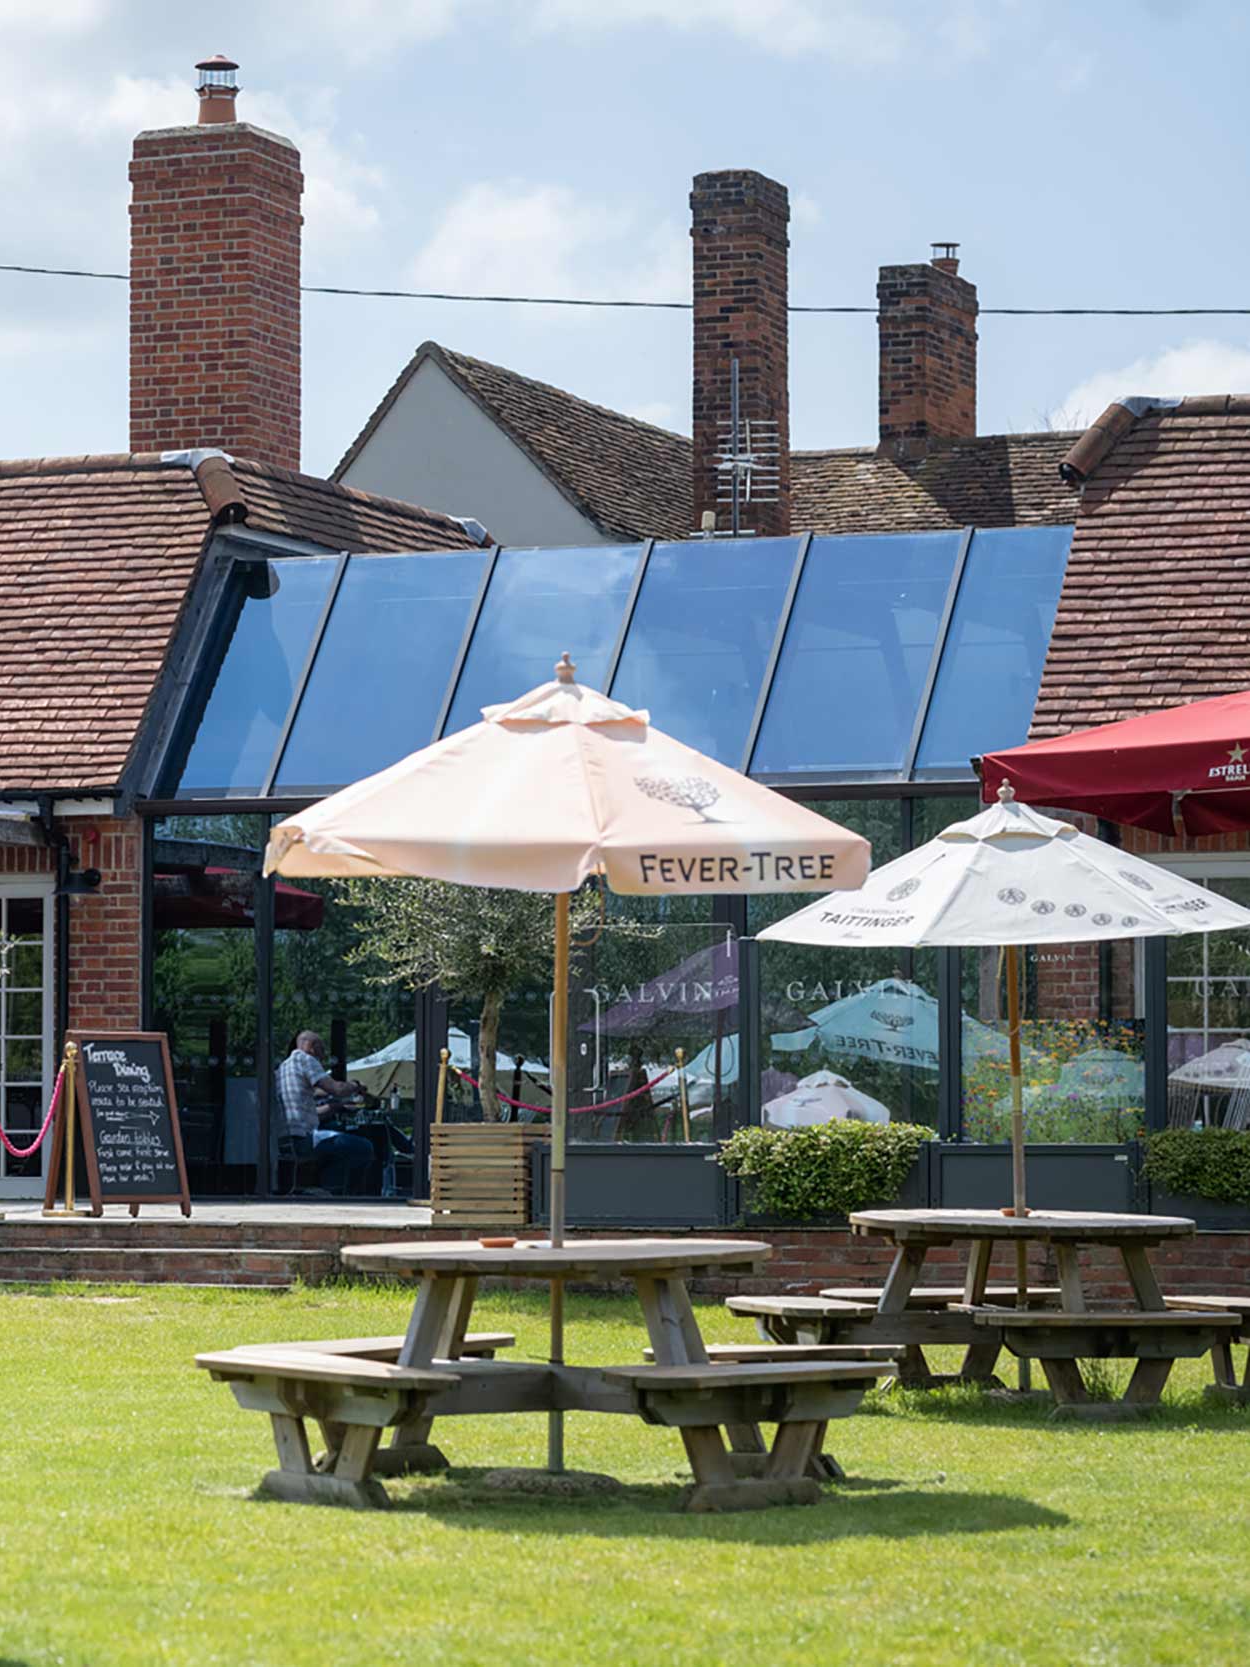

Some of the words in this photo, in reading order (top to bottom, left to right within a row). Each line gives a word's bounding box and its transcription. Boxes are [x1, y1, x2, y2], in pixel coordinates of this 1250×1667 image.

[639, 852, 835, 883] FEVER-TREE
[819, 911, 915, 928] TAITTINGER
[1030, 953, 1075, 963] GALVIN
[592, 982, 714, 1004] GALVIN
[786, 979, 913, 1002] GALVIN
[83, 1043, 126, 1063] Terrace
[113, 1062, 150, 1083] Dining
